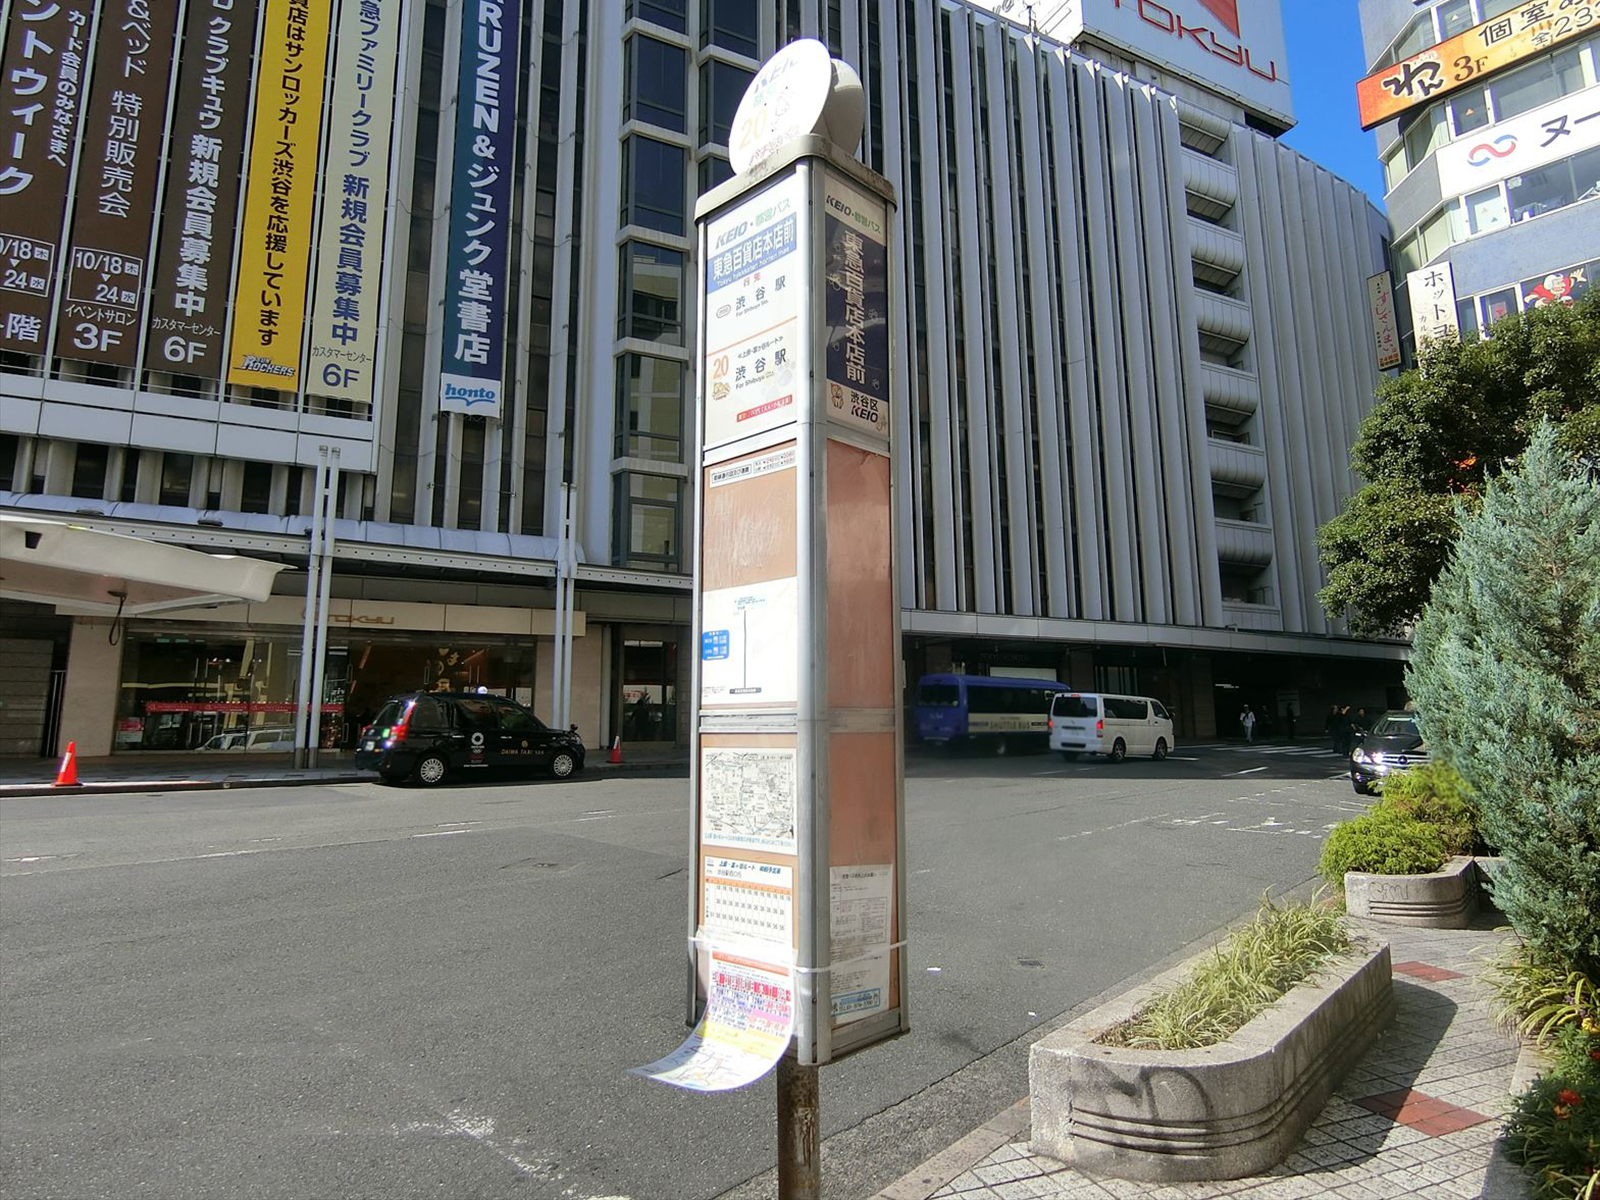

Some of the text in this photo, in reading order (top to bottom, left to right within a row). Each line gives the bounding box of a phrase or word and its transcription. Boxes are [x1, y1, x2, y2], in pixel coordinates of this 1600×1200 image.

[1114, 0, 1276, 82] OKYU
[1453, 55, 1488, 82] 3F
[48, 10, 86, 167] カード会員のみなさまへ
[98, 90, 142, 218] 特別販売会
[453, 0, 504, 365] RUZEN&ジュンク堂書店
[175, 134, 223, 317] 新規会員募集中
[331, 174, 369, 347] 新規会員募集中
[713, 217, 793, 282] 東急百貨店本店前
[76, 251, 122, 274] 10/18
[4, 269, 27, 289] 24
[96, 284, 119, 303] 24
[65, 304, 137, 326] イベントサロン
[845, 230, 866, 385] 東急百貨店本店前
[73, 322, 123, 352] 3F
[152, 317, 221, 337] カスタマーセンター
[163, 335, 208, 364] 6F
[312, 346, 372, 363] カスタマーセンター
[242, 355, 295, 377] ROCKERS
[322, 363, 360, 388] 6F
[713, 355, 729, 379] 20
[735, 348, 786, 382] 渋谷駅
[445, 383, 495, 399] honto
[850, 390, 879, 412] 渋谷区
[851, 405, 879, 423] KEIO
[990, 721, 1017, 730] SHUTTLE
[1019, 721, 1031, 730] BUS
